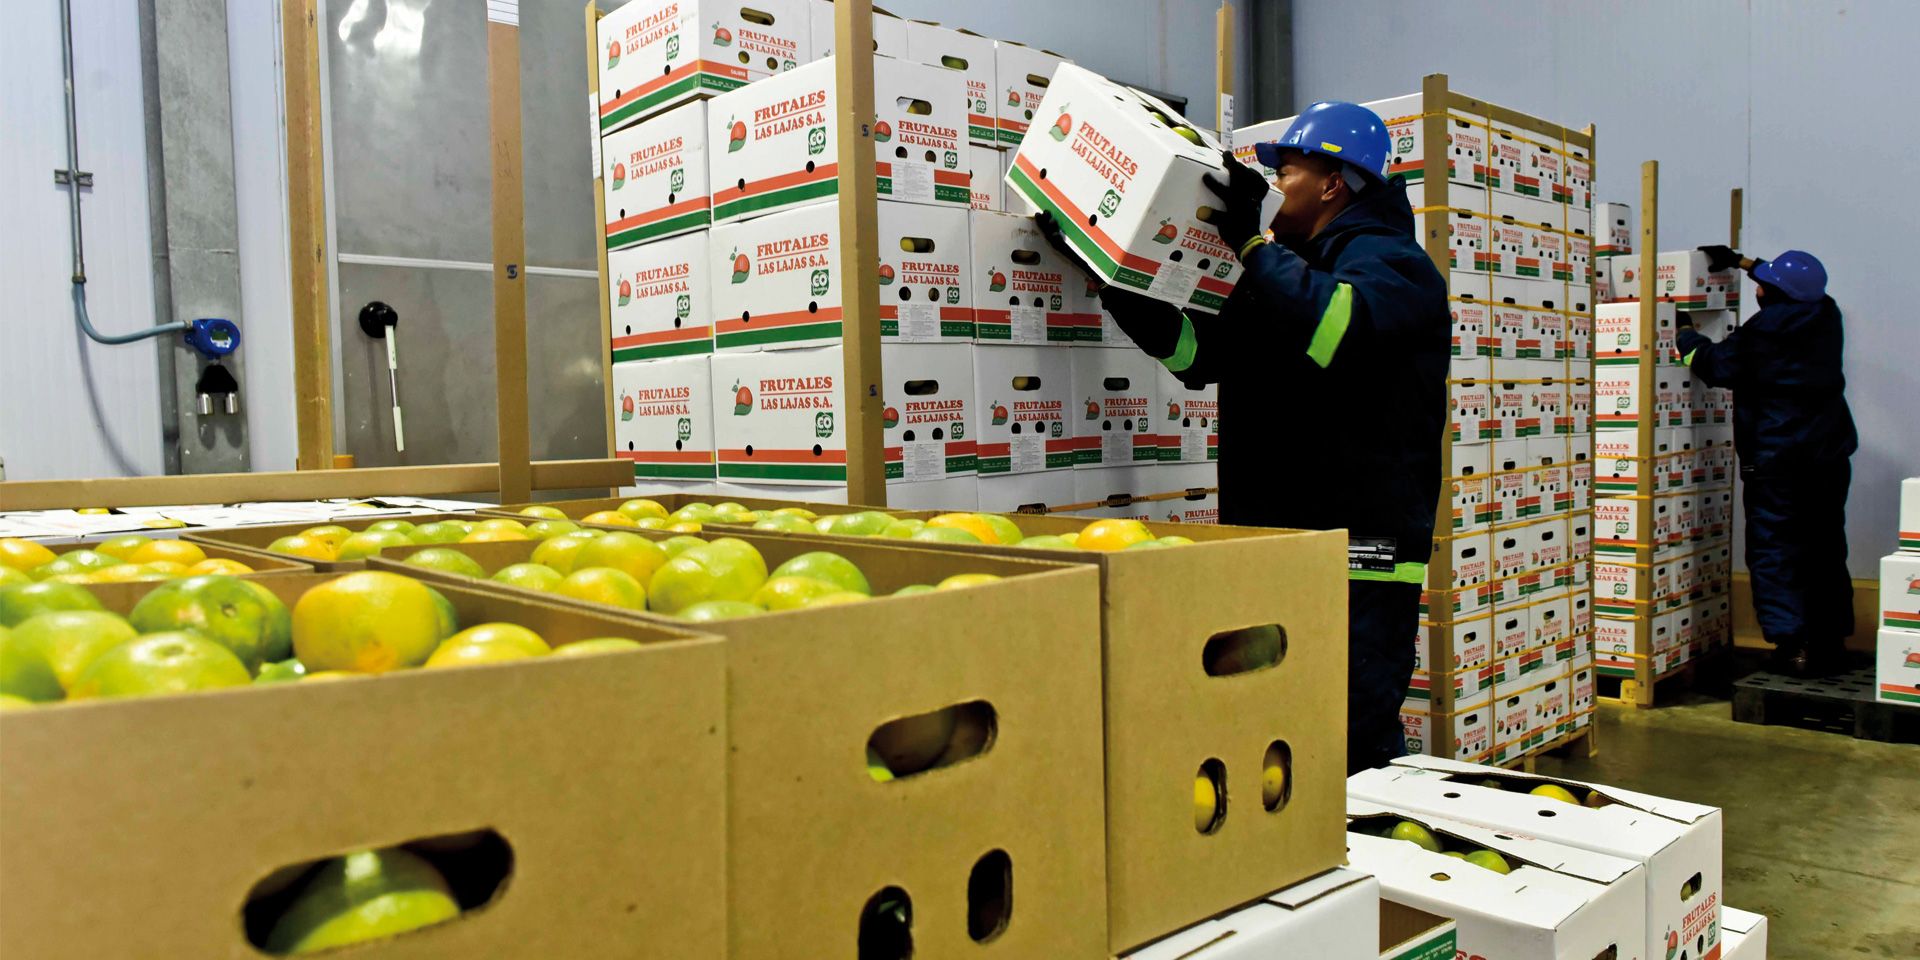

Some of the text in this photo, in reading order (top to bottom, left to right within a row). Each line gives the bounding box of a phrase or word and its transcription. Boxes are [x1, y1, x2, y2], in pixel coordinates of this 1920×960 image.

[625, 3, 678, 39] FRUTALES
[626, 20, 678, 55] LAS LAJAS S.A.
[739, 29, 796, 49] FRUTALES
[739, 41, 754, 50] LAS
[756, 44, 780, 56] LAJAS
[754, 90, 826, 123] FRUTALES
[755, 112, 825, 141] LAS LAJAS S.A.
[898, 121, 957, 137] FRUTALES
[900, 134, 957, 150] LAS LAJAS S.A.
[1080, 121, 1138, 175] FRUTALES
[631, 137, 683, 164] FRUTALES
[631, 158, 683, 180] LAS LAJAS S.A.
[1072, 139, 1125, 193] LAS LAJAS S.A.
[757, 233, 828, 257] FRUTALES
[1181, 239, 1197, 250] LAS
[1197, 244, 1222, 258] LAJAS
[758, 254, 828, 275] LAS LAJAS S.A.
[902, 262, 959, 273] FRUTALES
[636, 263, 689, 283] FRUTALES
[903, 275, 959, 286] LAS LAJAS S.A.
[1012, 270, 1062, 282] FRUTALES
[637, 281, 689, 299] LAS LAJAS S.A.
[1013, 282, 1062, 293] LAS LAJAS S.A.
[760, 376, 832, 392] FRUTALES
[639, 387, 690, 400] FRUTALES
[639, 404, 690, 416] LAS LAJAS S.A.
[761, 396, 832, 410] LAS LAJAS S.A.
[906, 400, 963, 411] FRUTALES
[1014, 401, 1062, 409] FRUTALES
[1105, 398, 1147, 406] FRUTALES
[907, 413, 963, 423] LAS LAJAS S.A.
[1028, 413, 1049, 421] LAJAS
[1683, 894, 1716, 929] FRUTALES
